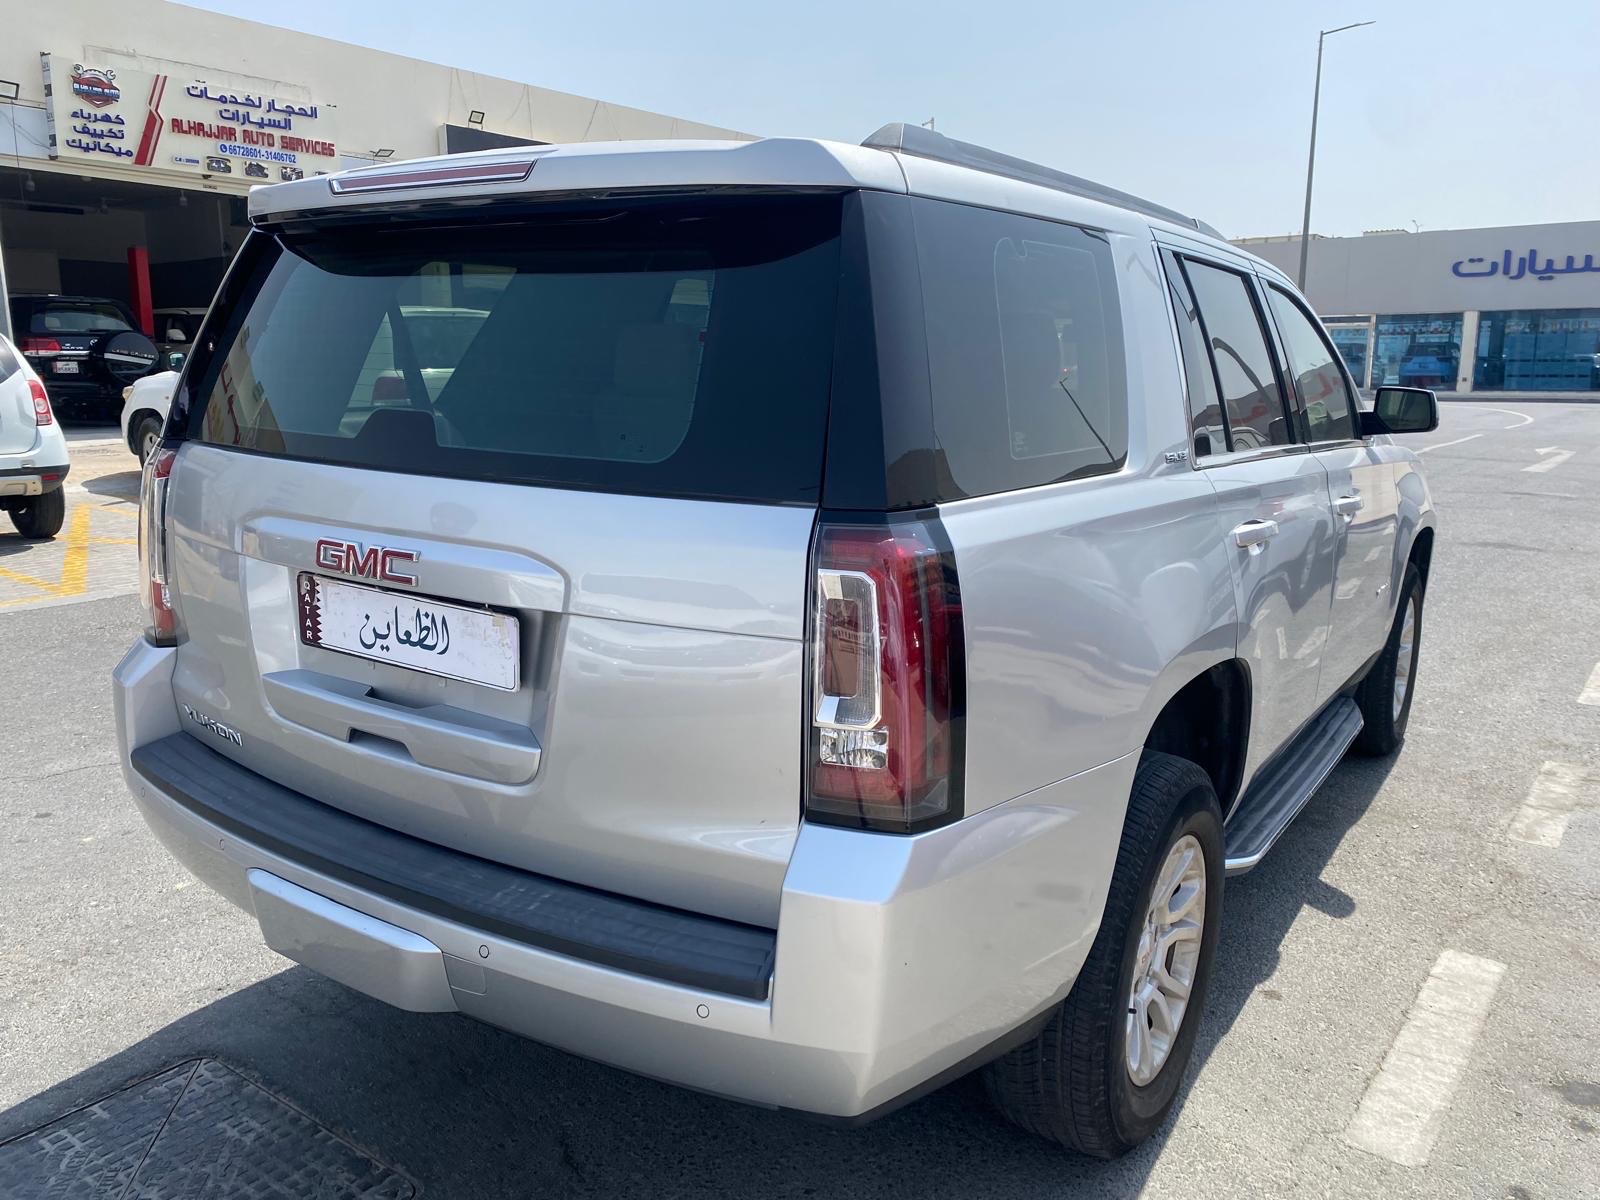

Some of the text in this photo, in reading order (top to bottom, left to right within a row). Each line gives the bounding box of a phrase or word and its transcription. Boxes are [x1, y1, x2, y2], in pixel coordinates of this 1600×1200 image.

[186, 85, 318, 119] الحجار لخدمات
[71, 108, 125, 125] كهرباء
[218, 109, 292, 131] السيارات
[73, 123, 125, 140] تكييف
[171, 118, 336, 158] ALHAJJAR AUTO SERVICES
[66, 138, 134, 157] ميكانيك
[228, 144, 297, 164] 66728601-31406762
[315, 536, 420, 587] GMC
[303, 580, 313, 640] QATAR
[359, 604, 450, 655] الظعاين
